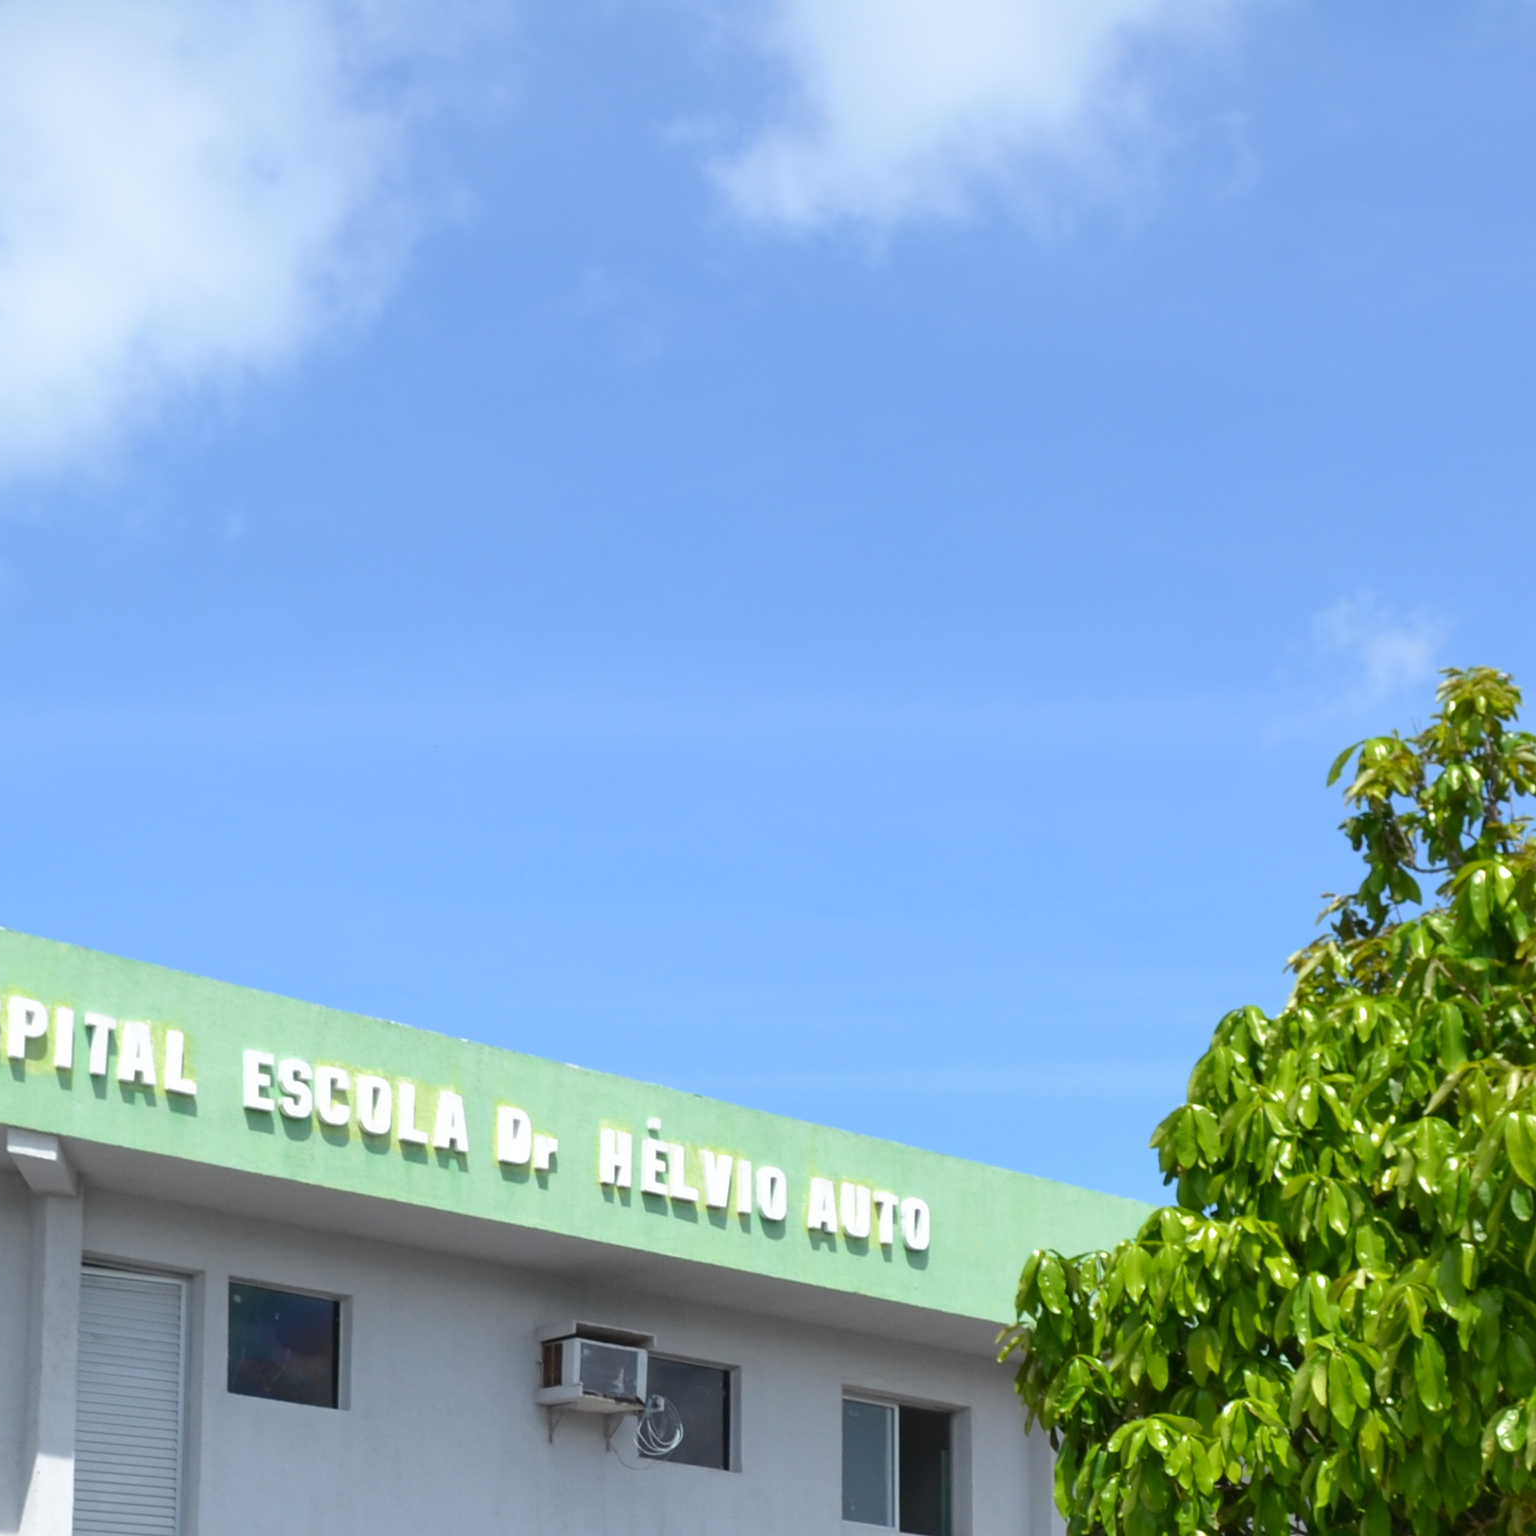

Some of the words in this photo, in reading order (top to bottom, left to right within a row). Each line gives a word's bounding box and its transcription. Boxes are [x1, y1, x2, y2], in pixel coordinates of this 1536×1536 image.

[243, 1048, 469, 1153] ESCOLA
[497, 1105, 559, 1170] Dr
[599, 1116, 788, 1222] HÉLVIO
[807, 1176, 931, 1251] AUTO
